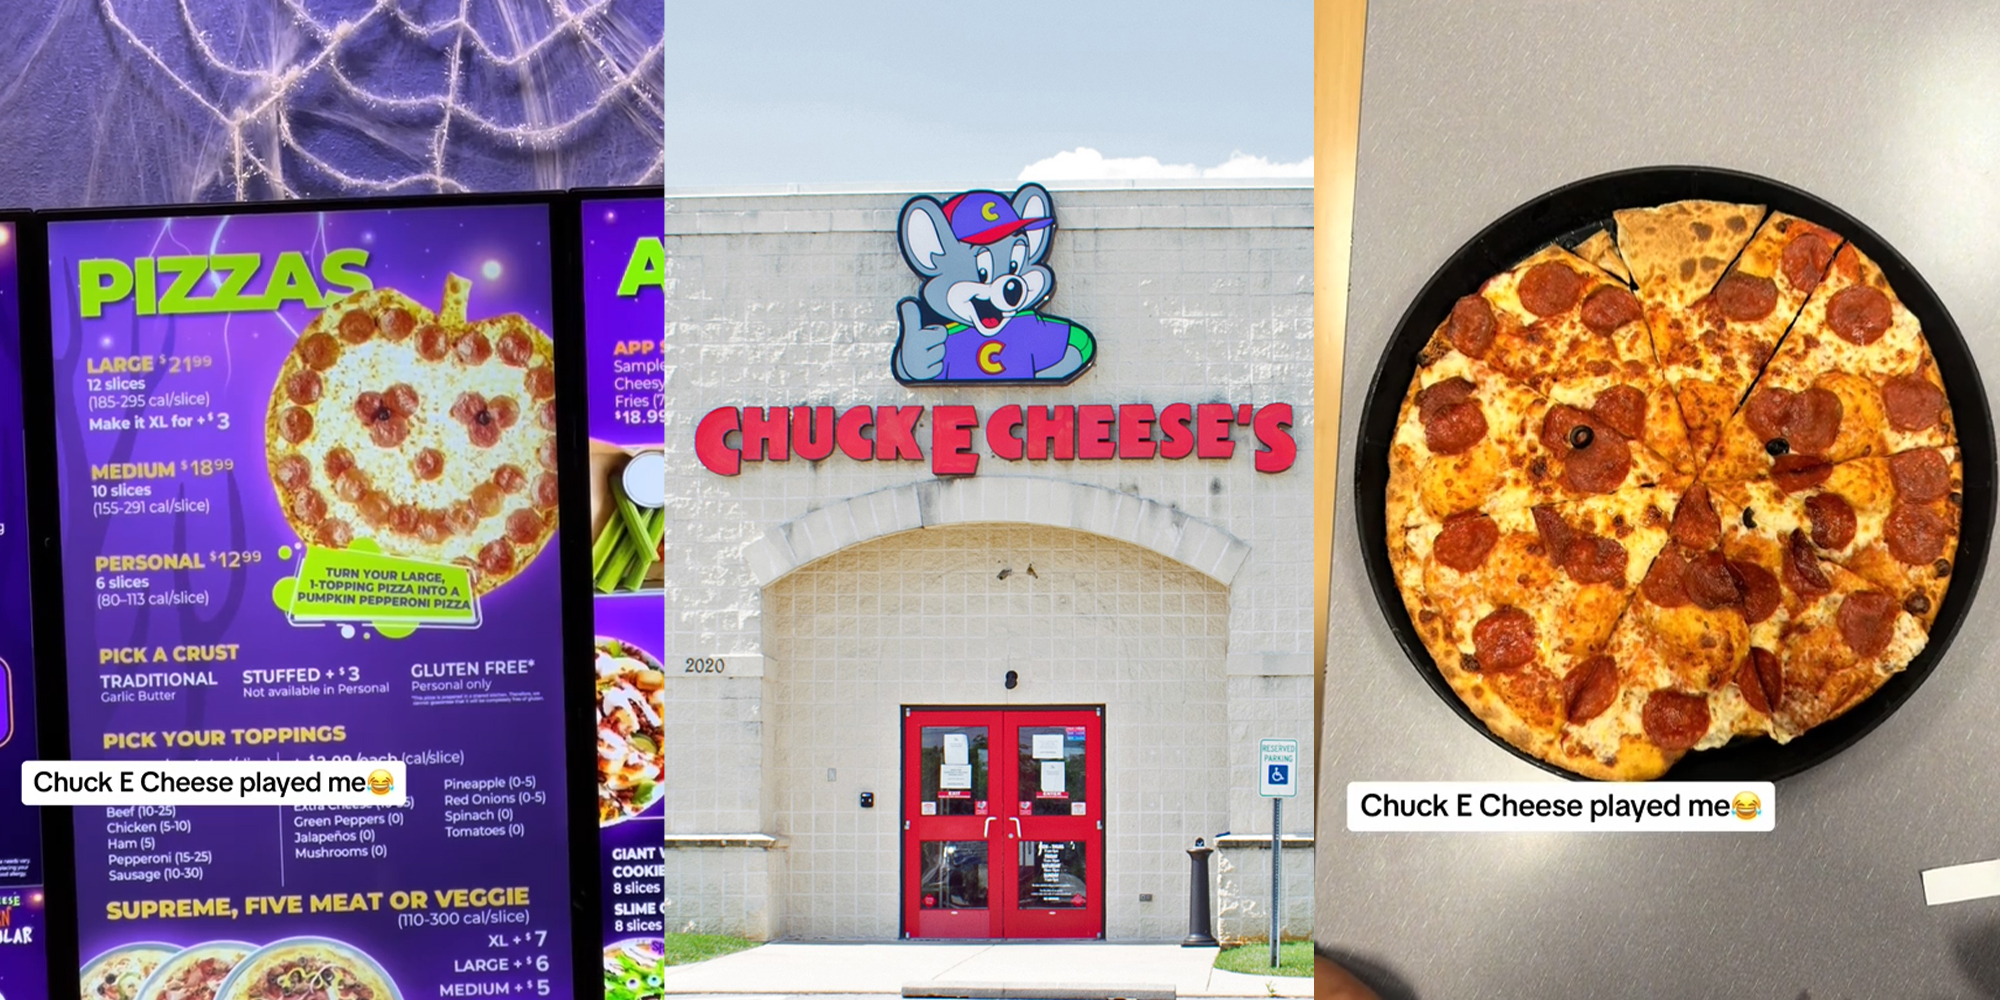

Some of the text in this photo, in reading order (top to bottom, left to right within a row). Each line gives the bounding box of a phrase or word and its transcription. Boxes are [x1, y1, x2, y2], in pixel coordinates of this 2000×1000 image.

[79, 248, 373, 318] PIZZAS
[614, 341, 655, 355] APP
[87, 356, 154, 374] LARGE
[87, 376, 146, 392] 12 slices
[89, 391, 210, 412] (185-295 cal/slice)
[616, 394, 649, 408] Fries
[89, 416, 131, 431] Make
[134, 415, 145, 429] it
[149, 415, 168, 429] XL
[171, 414, 193, 428] for
[694, 402, 1298, 477] CHUCK E CHEESE'S
[91, 461, 175, 480] MEDIUM
[91, 482, 151, 497] 10 slices
[93, 497, 210, 518] (155-291 cal/slice)
[95, 553, 206, 572] PERSONAL
[96, 574, 150, 589] 6 slices
[325, 567, 446, 585] TURN YOUR LARGE,
[309, 579, 460, 597] 1-TOPPING PIZZA INTO A
[148, 590, 209, 606] cal/slice)
[297, 591, 472, 610] PUMPKIN PEPPERONI PIZZA
[99, 644, 239, 664] PICK A CRUST
[411, 662, 479, 677] GLUTEN
[685, 658, 725, 673] 2020
[100, 671, 218, 689] TRADITIONAL
[242, 668, 320, 684] STUFFED
[243, 682, 389, 698] Not available in Personal
[412, 678, 492, 691] Personal only
[101, 690, 175, 703] Garlic Butter
[103, 726, 346, 749] PICK YOUR TOPPINGS
[1264, 754, 1293, 762] PARKING
[444, 776, 536, 791] Pineapple (0-5)
[445, 791, 546, 806] Red Onions (0-5)
[106, 805, 176, 819] Beef (10-25)
[445, 808, 514, 823] Spinach (0)
[107, 820, 191, 834] Chicken (5-10)
[294, 812, 404, 828] Green Peppers (0)
[294, 829, 375, 844] Jalapeños (0)
[445, 823, 525, 837] Tomatoes (0)
[108, 837, 155, 851] Ham (5)
[295, 844, 387, 859] Mushrooms (0)
[109, 851, 212, 867] Pepperoni (15-25)
[612, 847, 656, 860] GIANT
[109, 867, 203, 882] Sausage (10-30)
[613, 881, 661, 894] 8 slices
[106, 887, 530, 920] SUPREME, FIVE MEAT OR VEGGIE
[614, 903, 656, 915] SLIME
[398, 910, 530, 929] (110-300 cal/slice)
[615, 919, 662, 932] 8 slices
[488, 935, 508, 948] XL
[454, 959, 509, 973] LARGE
[439, 982, 510, 997] MEDIUM
